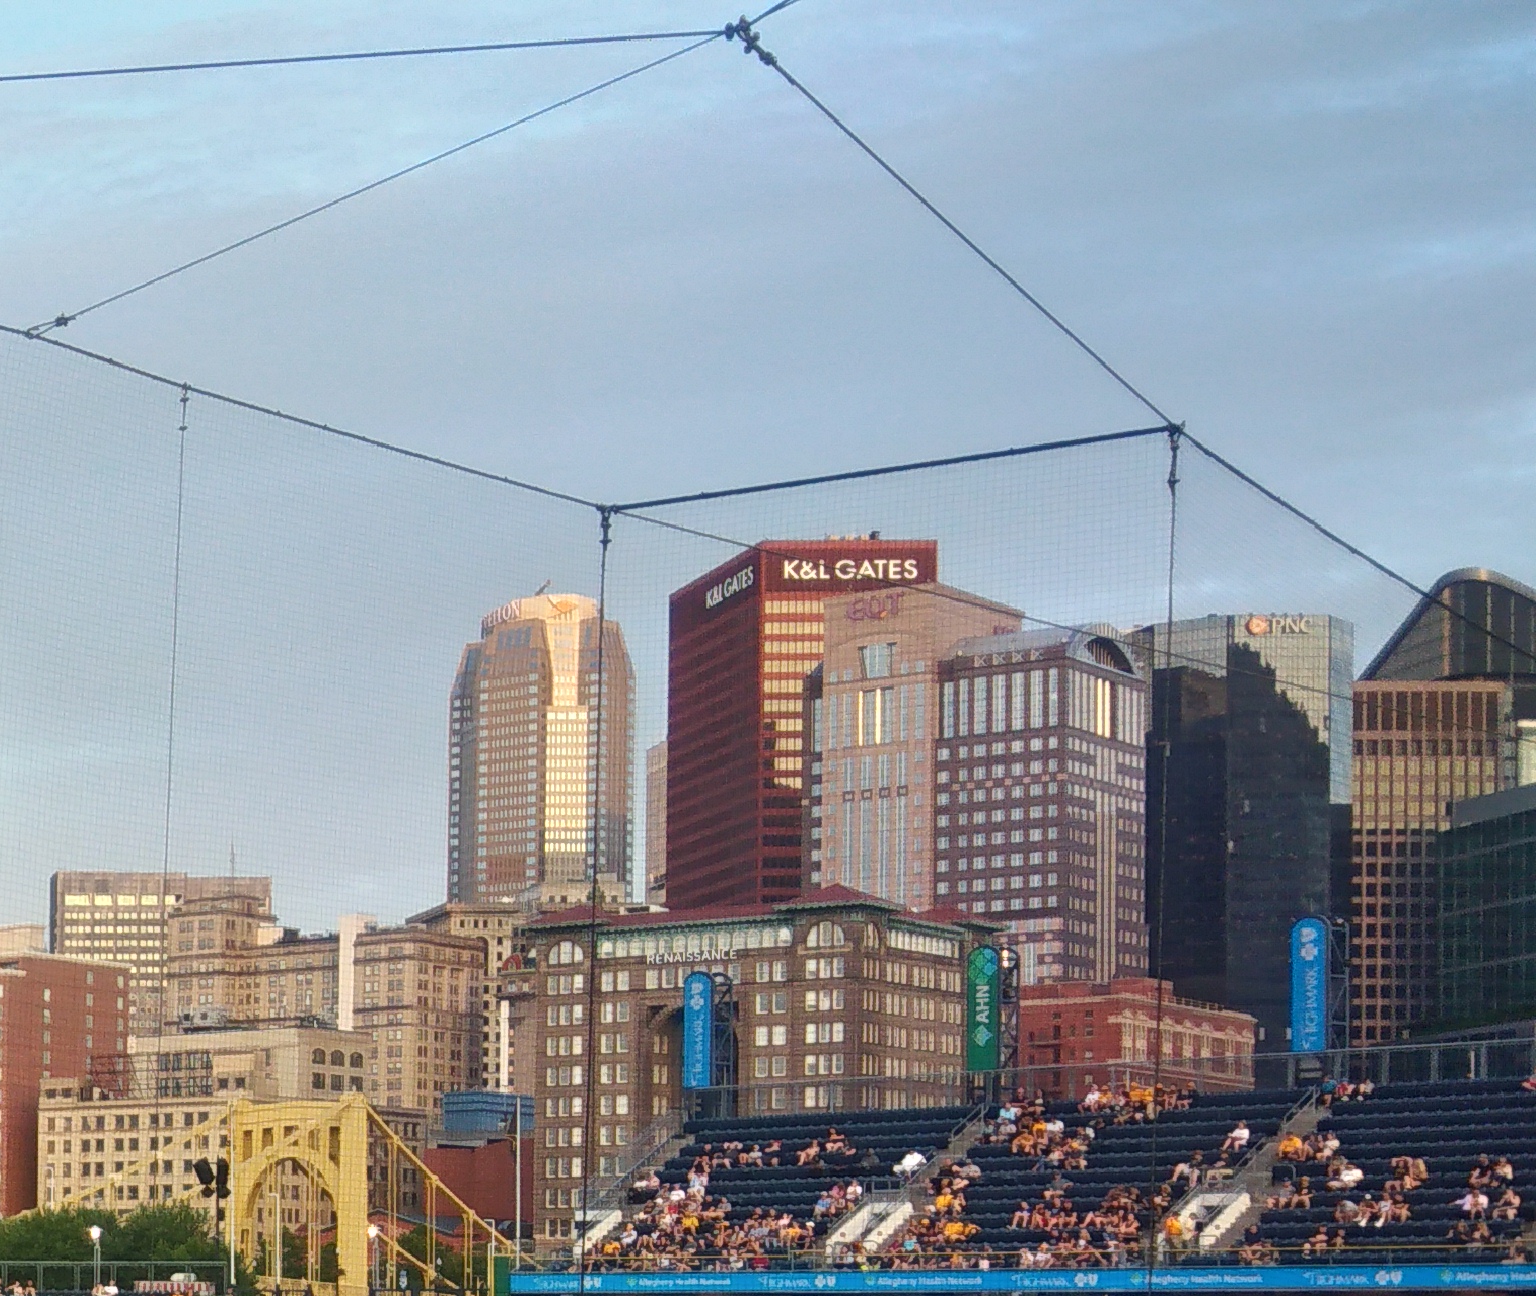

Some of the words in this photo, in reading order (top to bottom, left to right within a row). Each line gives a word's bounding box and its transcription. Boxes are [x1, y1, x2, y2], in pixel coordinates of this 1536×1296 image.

[784, 560, 830, 580] K&L
[835, 559, 919, 581] GATES
[705, 585, 725, 611] K&L
[723, 565, 754, 599] GATES
[1272, 618, 1313, 635] PNC
[646, 949, 738, 965] RENAISSANCE
[975, 985, 990, 1024] AHN
